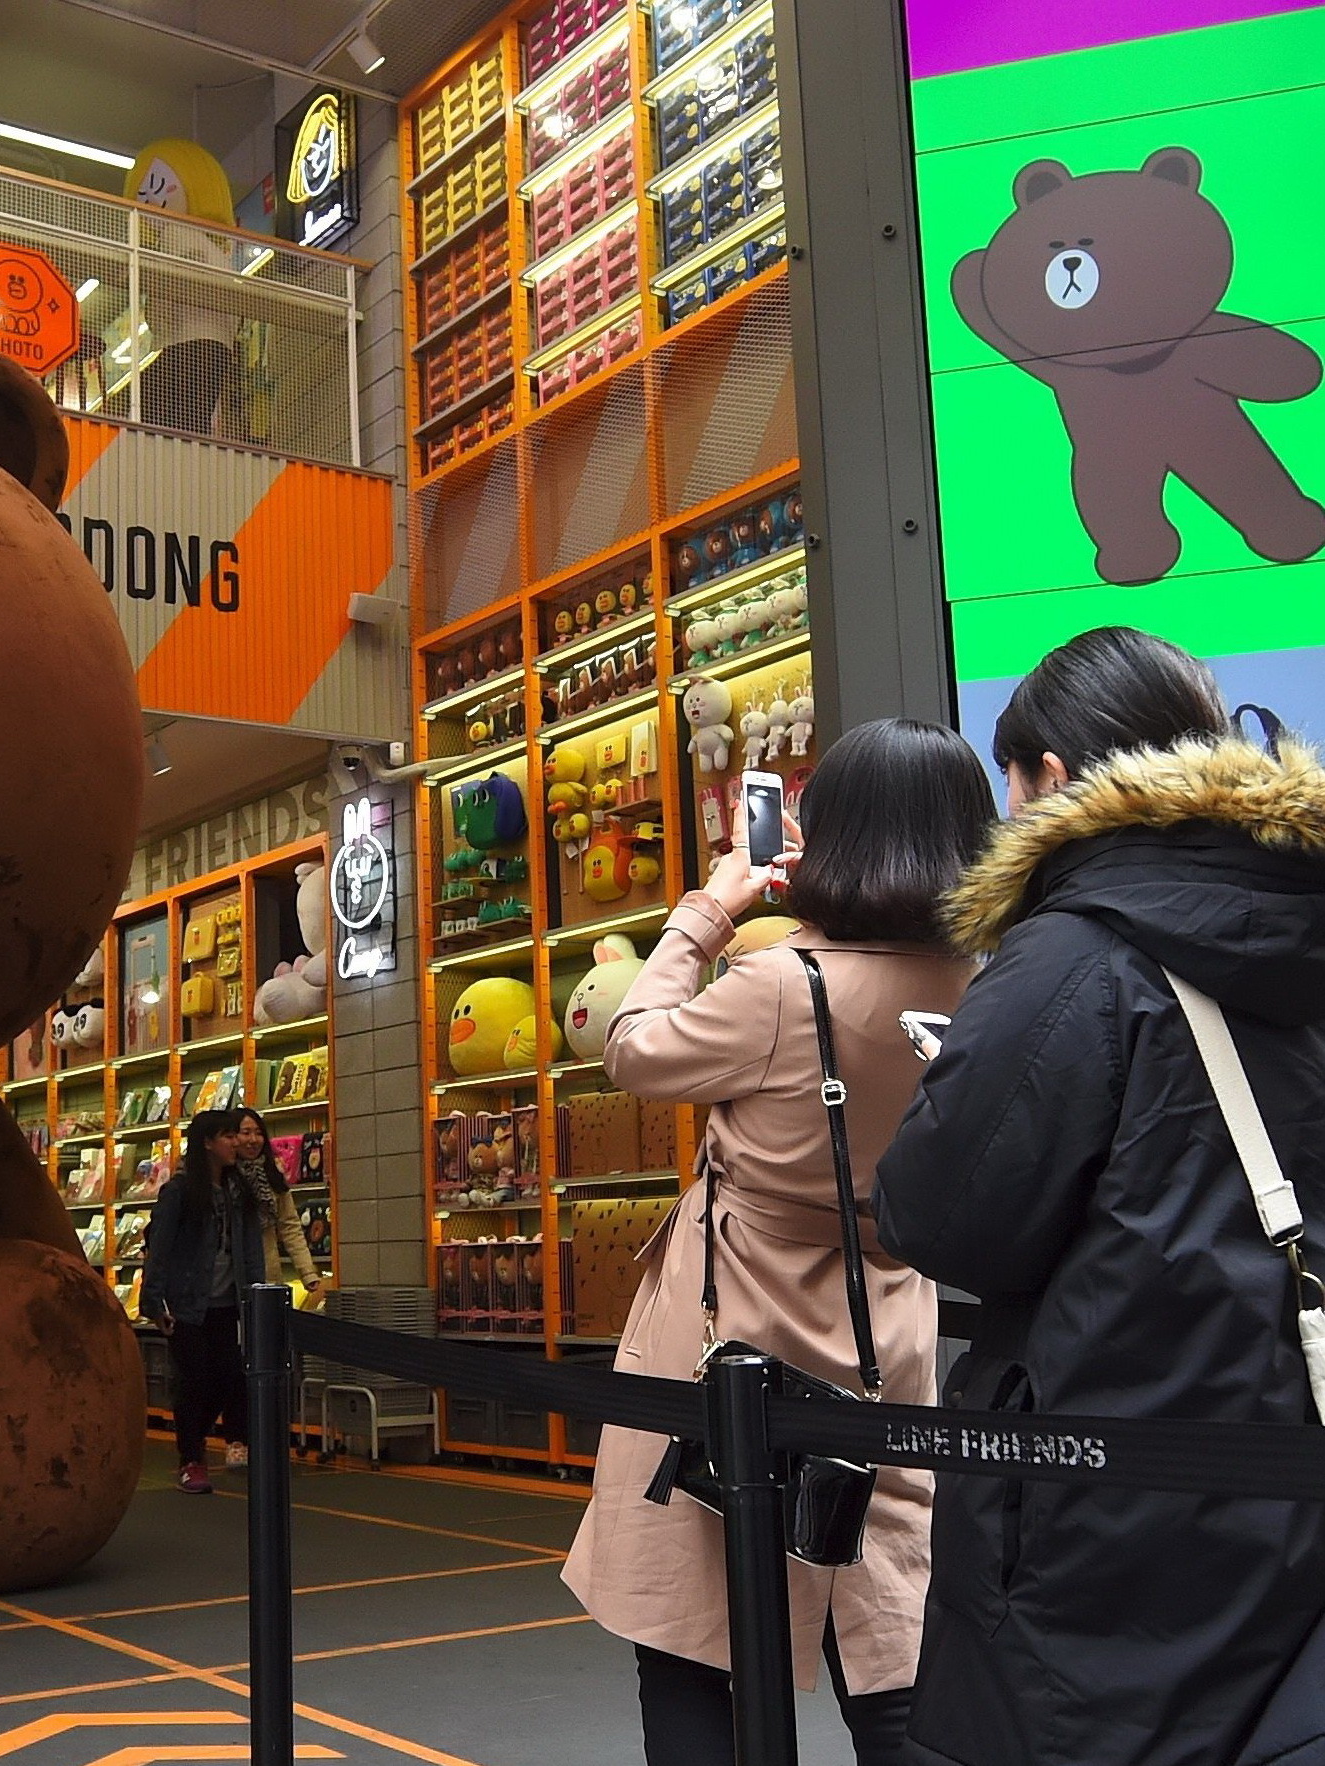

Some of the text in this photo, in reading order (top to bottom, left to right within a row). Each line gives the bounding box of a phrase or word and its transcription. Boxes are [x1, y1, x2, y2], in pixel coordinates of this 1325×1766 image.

[56, 512, 240, 613] DONG
[145, 774, 330, 896] FRIENDS
[886, 1423, 1108, 1468] LINE FRIENDS
